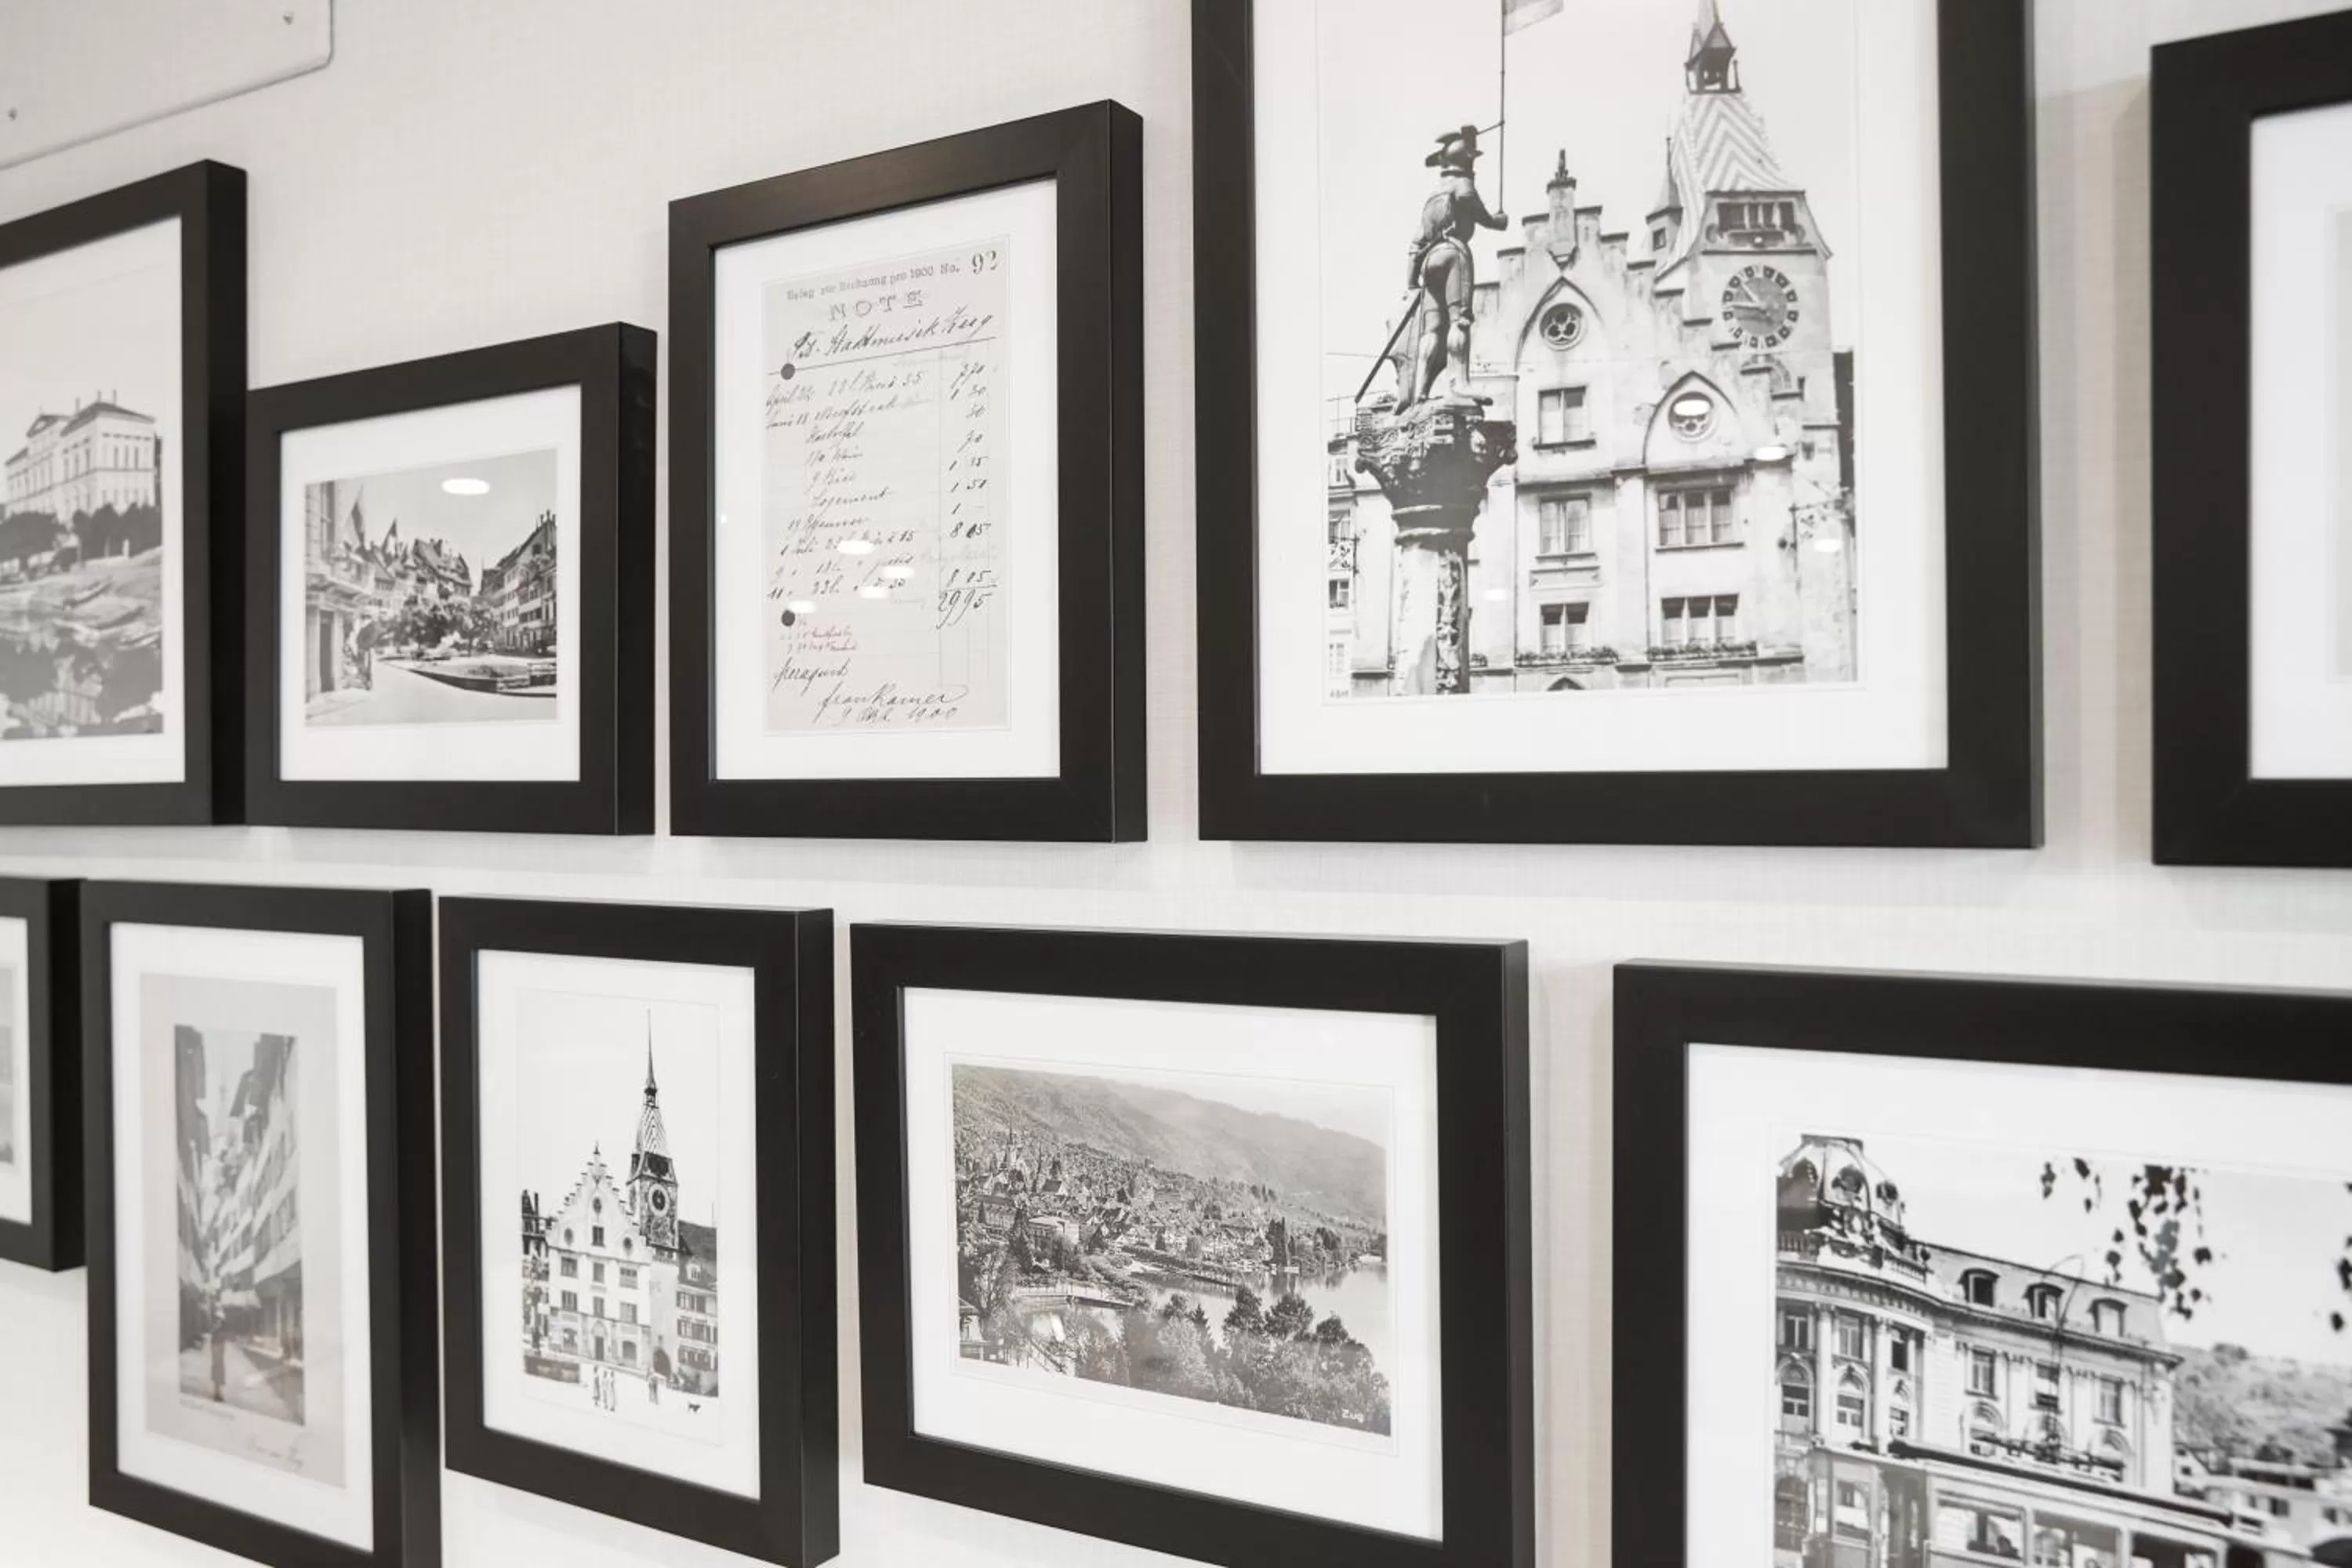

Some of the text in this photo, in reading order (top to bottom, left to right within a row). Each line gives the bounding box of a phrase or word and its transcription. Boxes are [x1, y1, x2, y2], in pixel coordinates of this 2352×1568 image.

[890, 270, 907, 285] pro
[910, 265, 934, 279] 1900
[971, 249, 998, 274] 92
[1341, 1409, 1364, 1424] Zug
